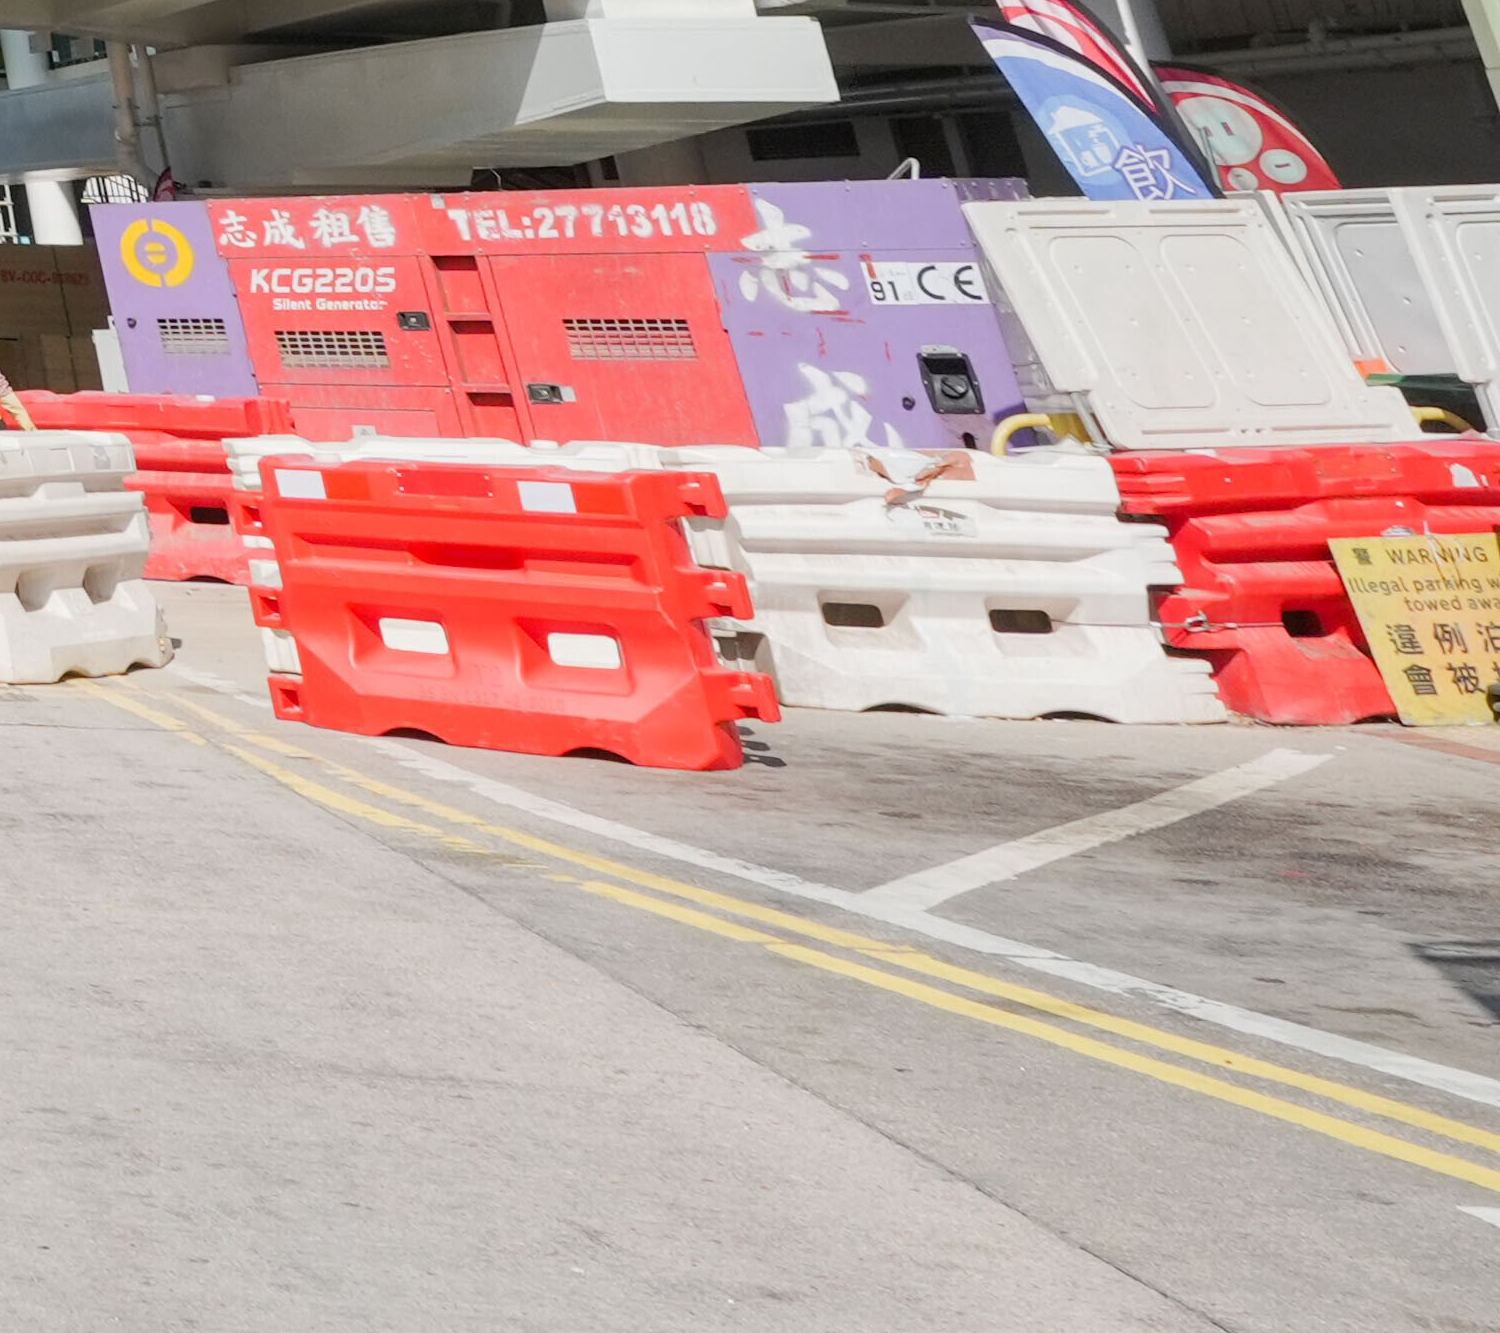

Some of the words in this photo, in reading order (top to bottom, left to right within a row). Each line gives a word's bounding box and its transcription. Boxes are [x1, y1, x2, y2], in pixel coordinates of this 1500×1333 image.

[218, 204, 397, 250] 志成租售
[446, 202, 718, 241] TEL:27713118
[250, 267, 397, 295] KCG220S
[870, 281, 900, 302] 91
[916, 264, 984, 301] CE
[272, 297, 312, 311] Silent
[1385, 546, 1489, 565] WARNING
[1348, 577, 1409, 596] Illegal
[1415, 578, 1483, 595] parking
[1404, 596, 1462, 612] towed
[1403, 661, 1500, 697] 會被
